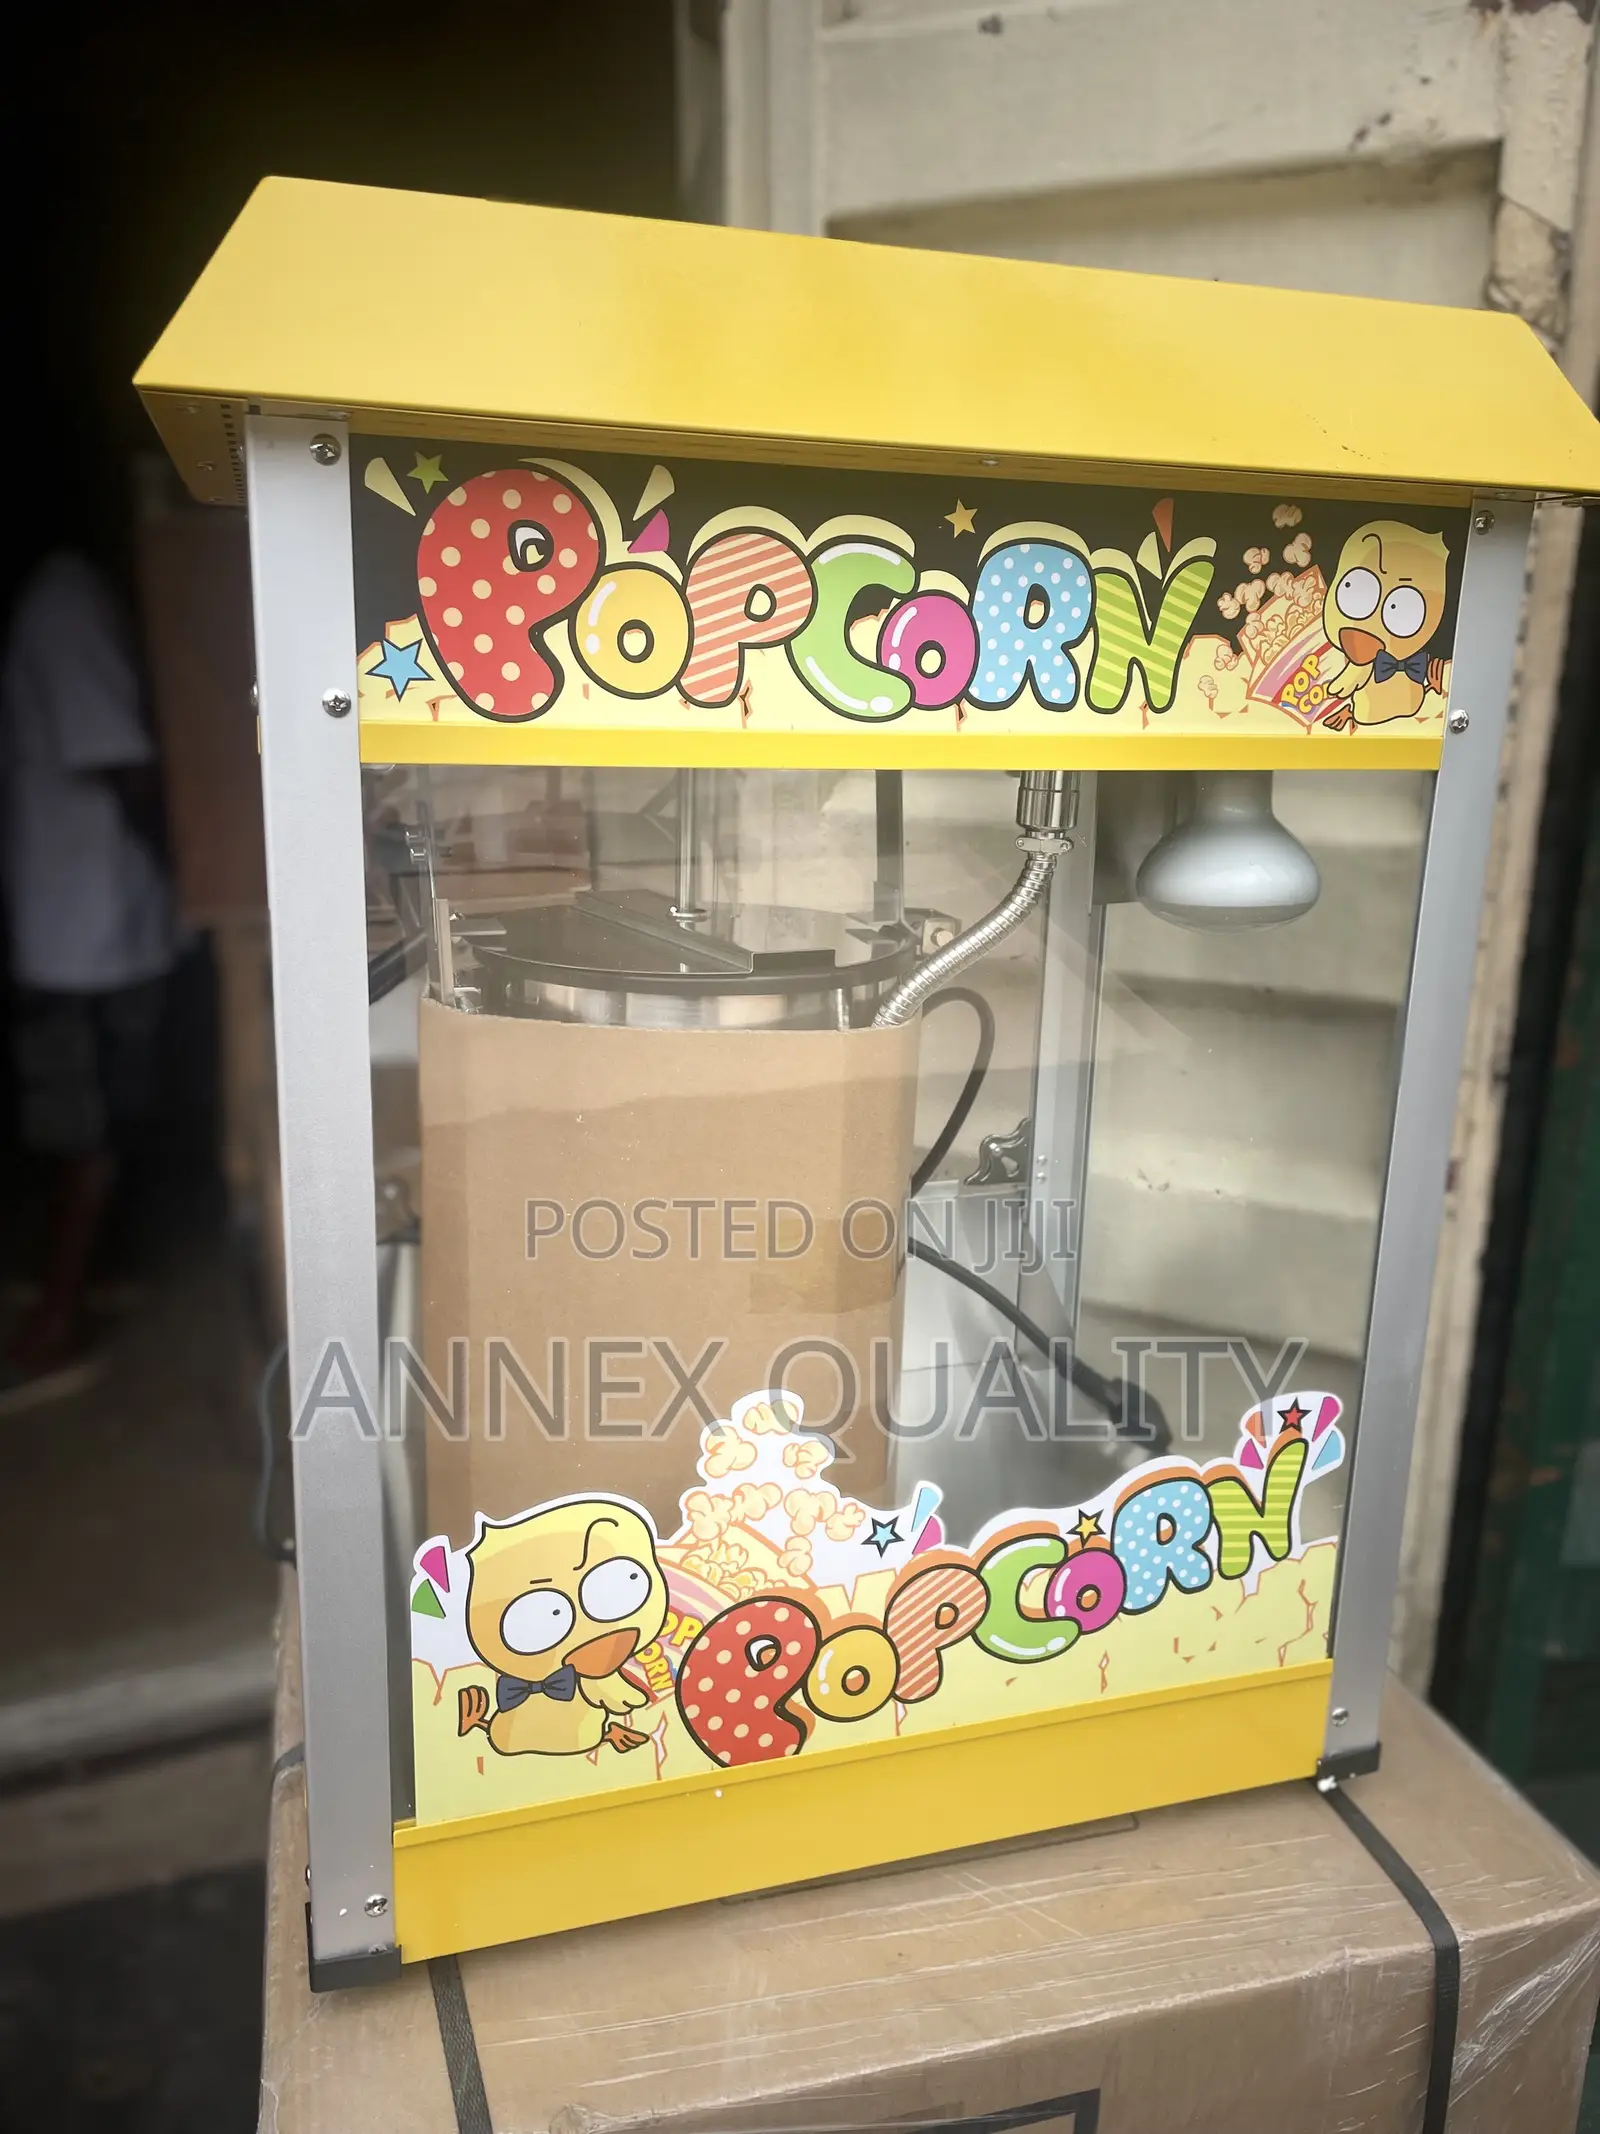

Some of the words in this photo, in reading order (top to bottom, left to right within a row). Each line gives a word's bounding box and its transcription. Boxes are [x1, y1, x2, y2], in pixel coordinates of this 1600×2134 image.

[1281, 654, 1320, 706] POP
[659, 1611, 704, 1647] OP
[633, 1640, 674, 1692] ORN
